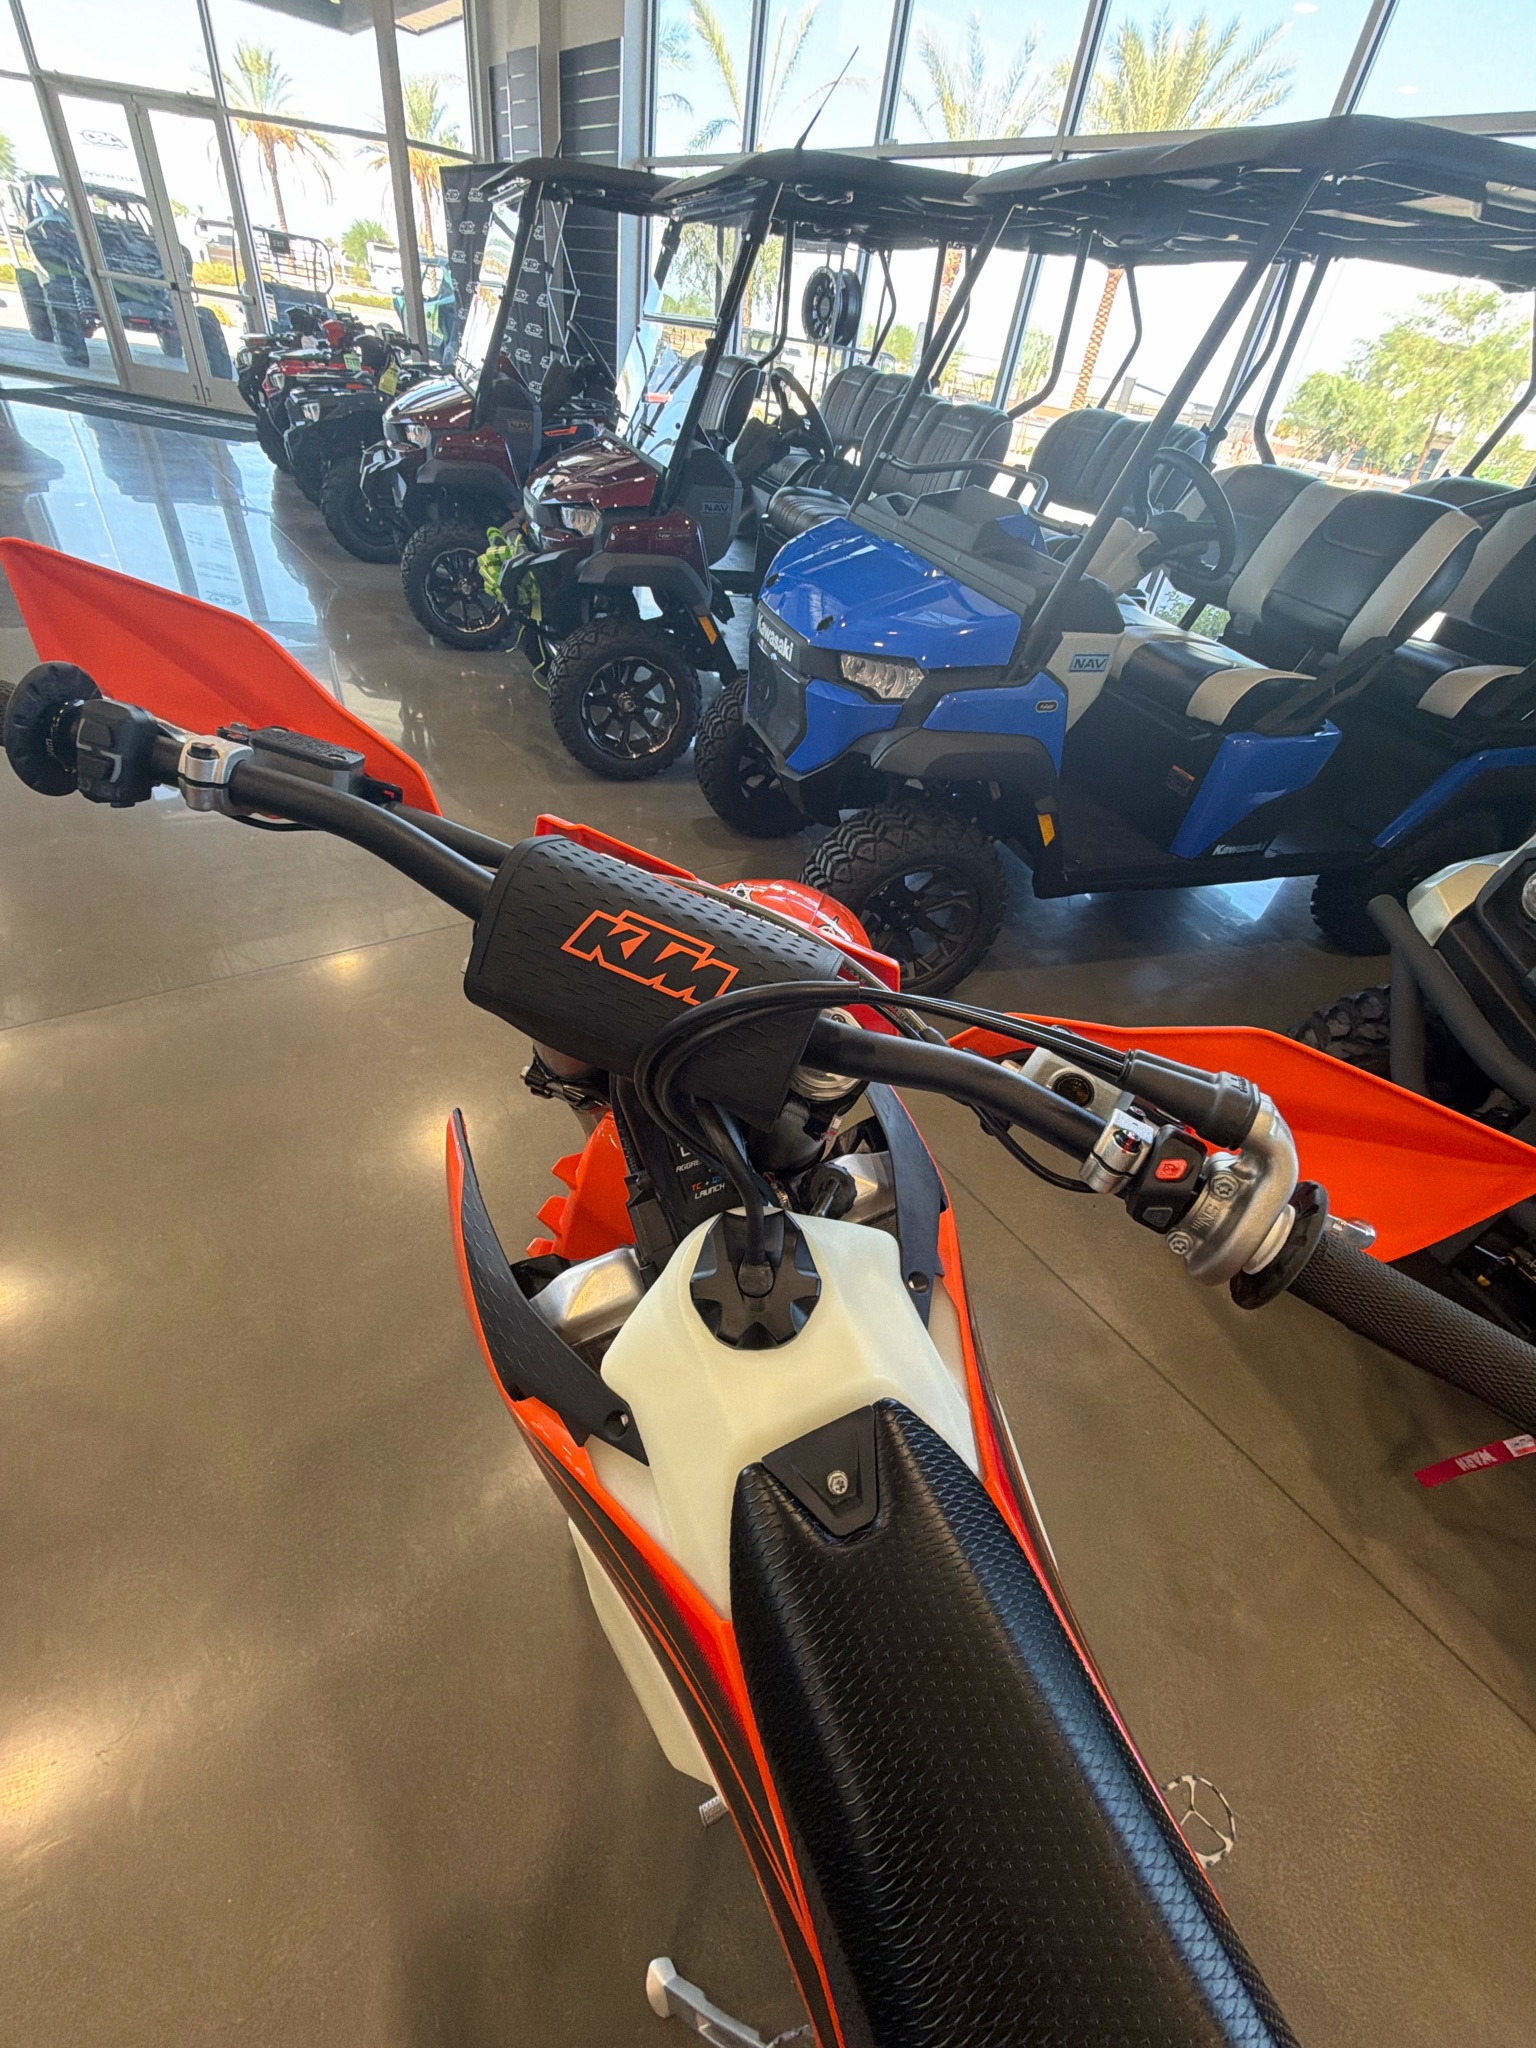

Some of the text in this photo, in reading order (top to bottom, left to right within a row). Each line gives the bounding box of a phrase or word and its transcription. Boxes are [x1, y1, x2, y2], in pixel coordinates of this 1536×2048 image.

[704, 504, 729, 512] NAV
[756, 611, 794, 662] Kawasaki
[1073, 658, 1107, 669] NAV
[1212, 841, 1269, 857] Kawasaki
[560, 909, 740, 1006] KTM
[675, 1160, 703, 1173] AGGRE
[691, 1181, 702, 1191] TC
[694, 1182, 726, 1200] LAUNCH
